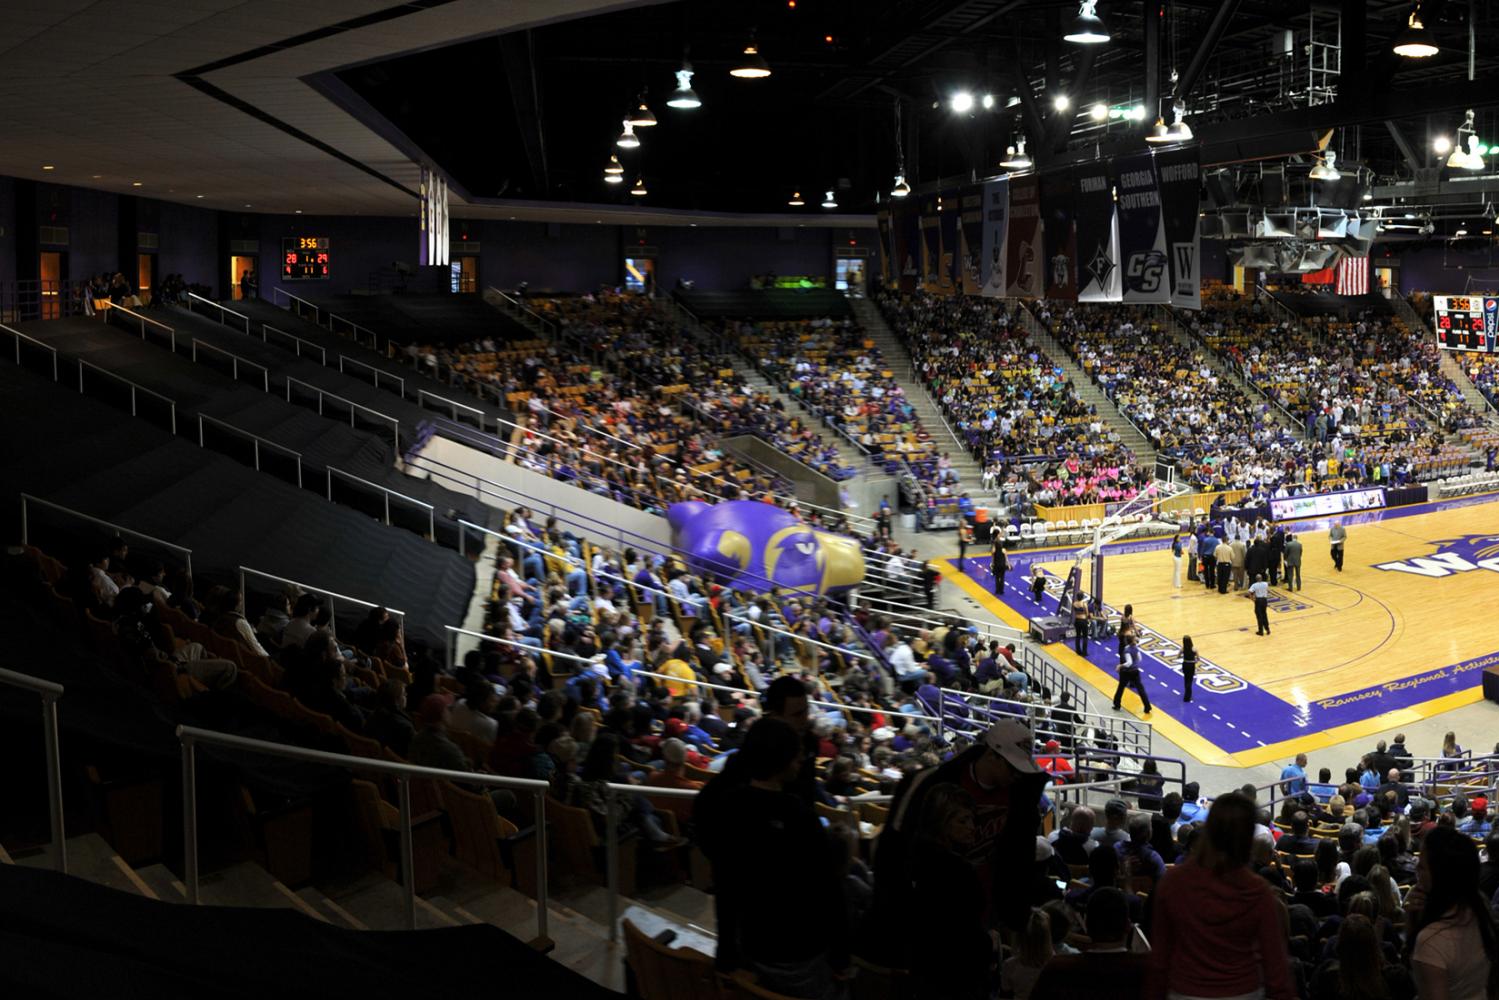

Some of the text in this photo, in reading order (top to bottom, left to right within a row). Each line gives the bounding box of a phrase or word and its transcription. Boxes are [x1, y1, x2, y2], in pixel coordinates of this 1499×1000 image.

[1120, 169, 1154, 188] GEORGIA
[1161, 162, 1199, 183] WOFFORD
[1080, 176, 1107, 193] FURMAN
[1120, 190, 1160, 210] SOUTHERN
[286, 253, 297, 264] 28
[317, 253, 328, 264] 29
[1440, 317, 1451, 329] 28
[1472, 318, 1483, 331] 29
[1317, 689, 1383, 710] Ramsey
[1383, 670, 1450, 692] Regional
